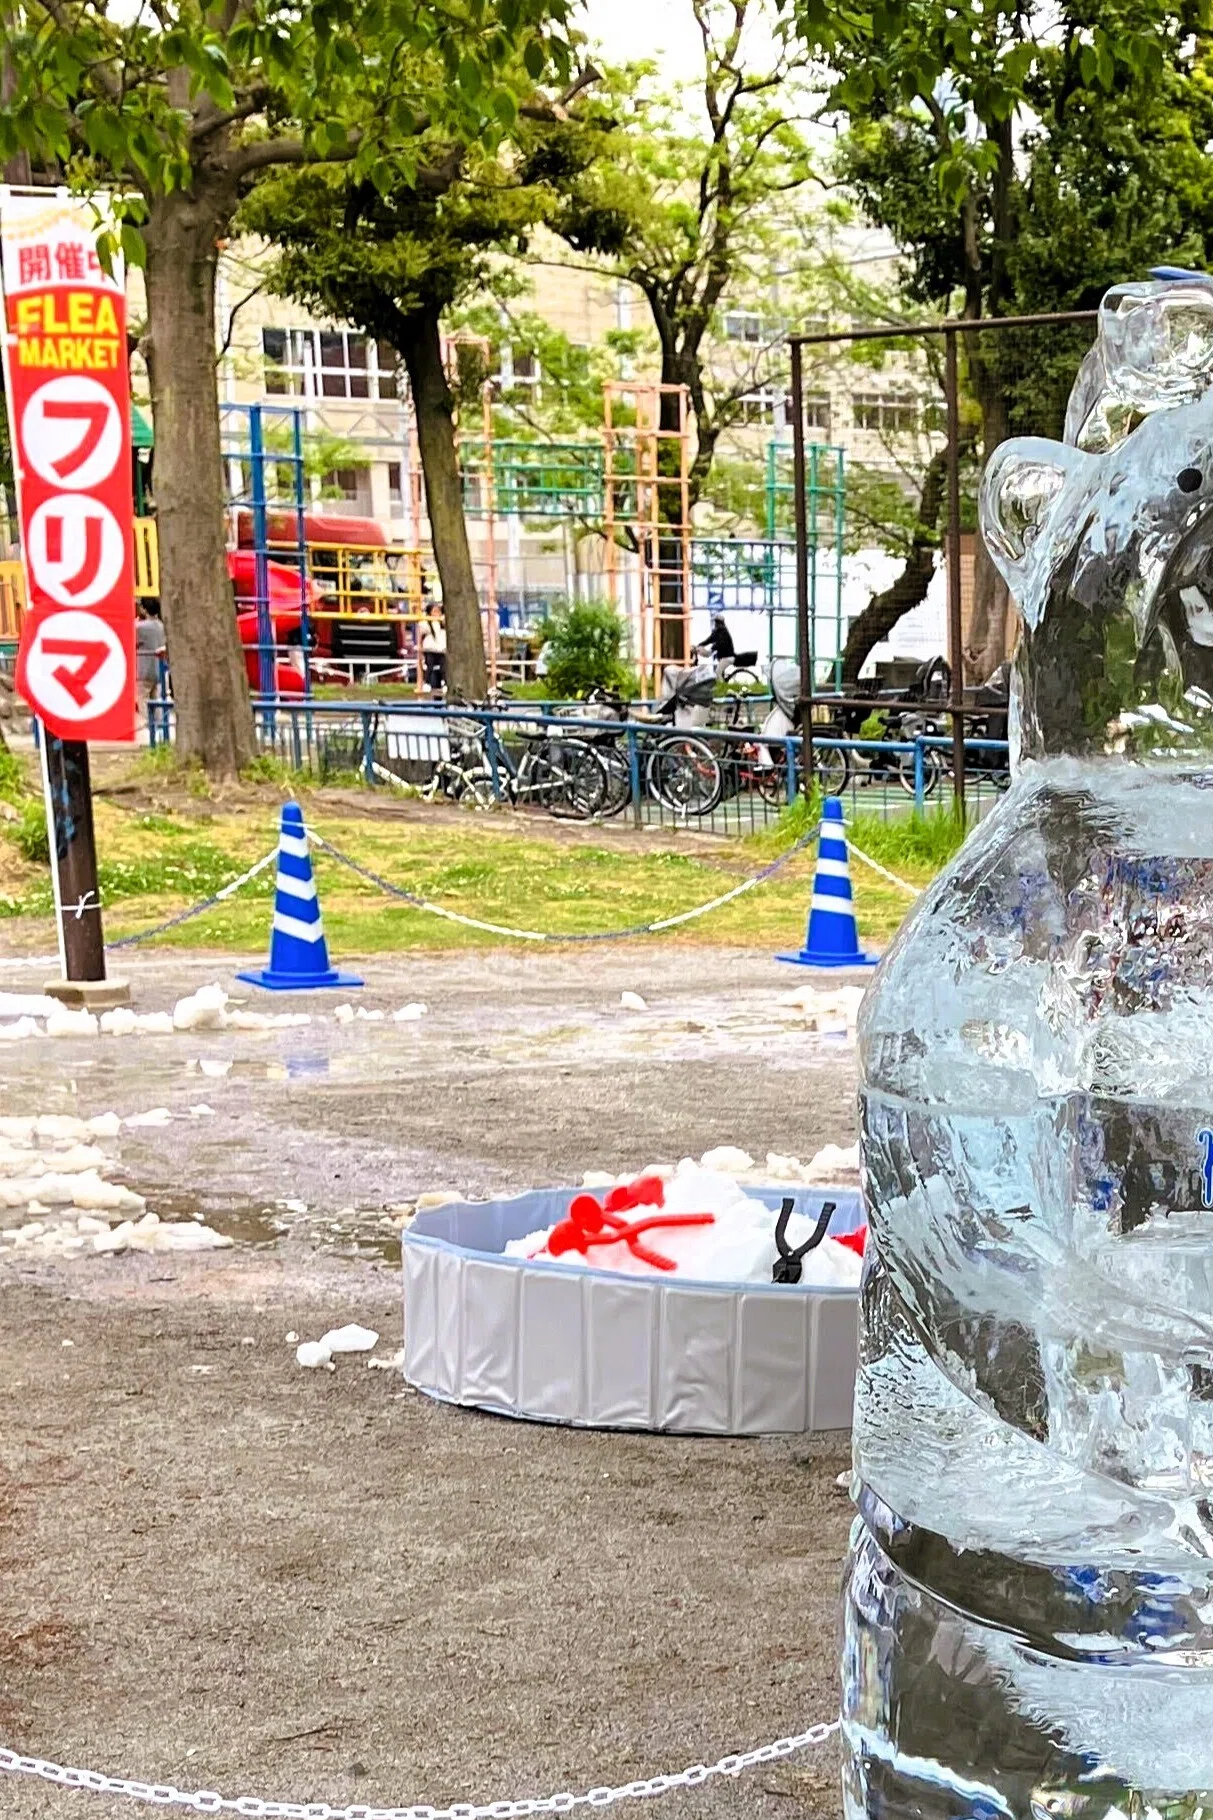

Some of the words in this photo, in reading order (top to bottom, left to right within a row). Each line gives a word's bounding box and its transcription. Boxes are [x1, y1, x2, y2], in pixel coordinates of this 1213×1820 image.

[17, 293, 119, 336] FLEA
[18, 335, 120, 371] MARKET
[41, 400, 112, 709] フリマ
